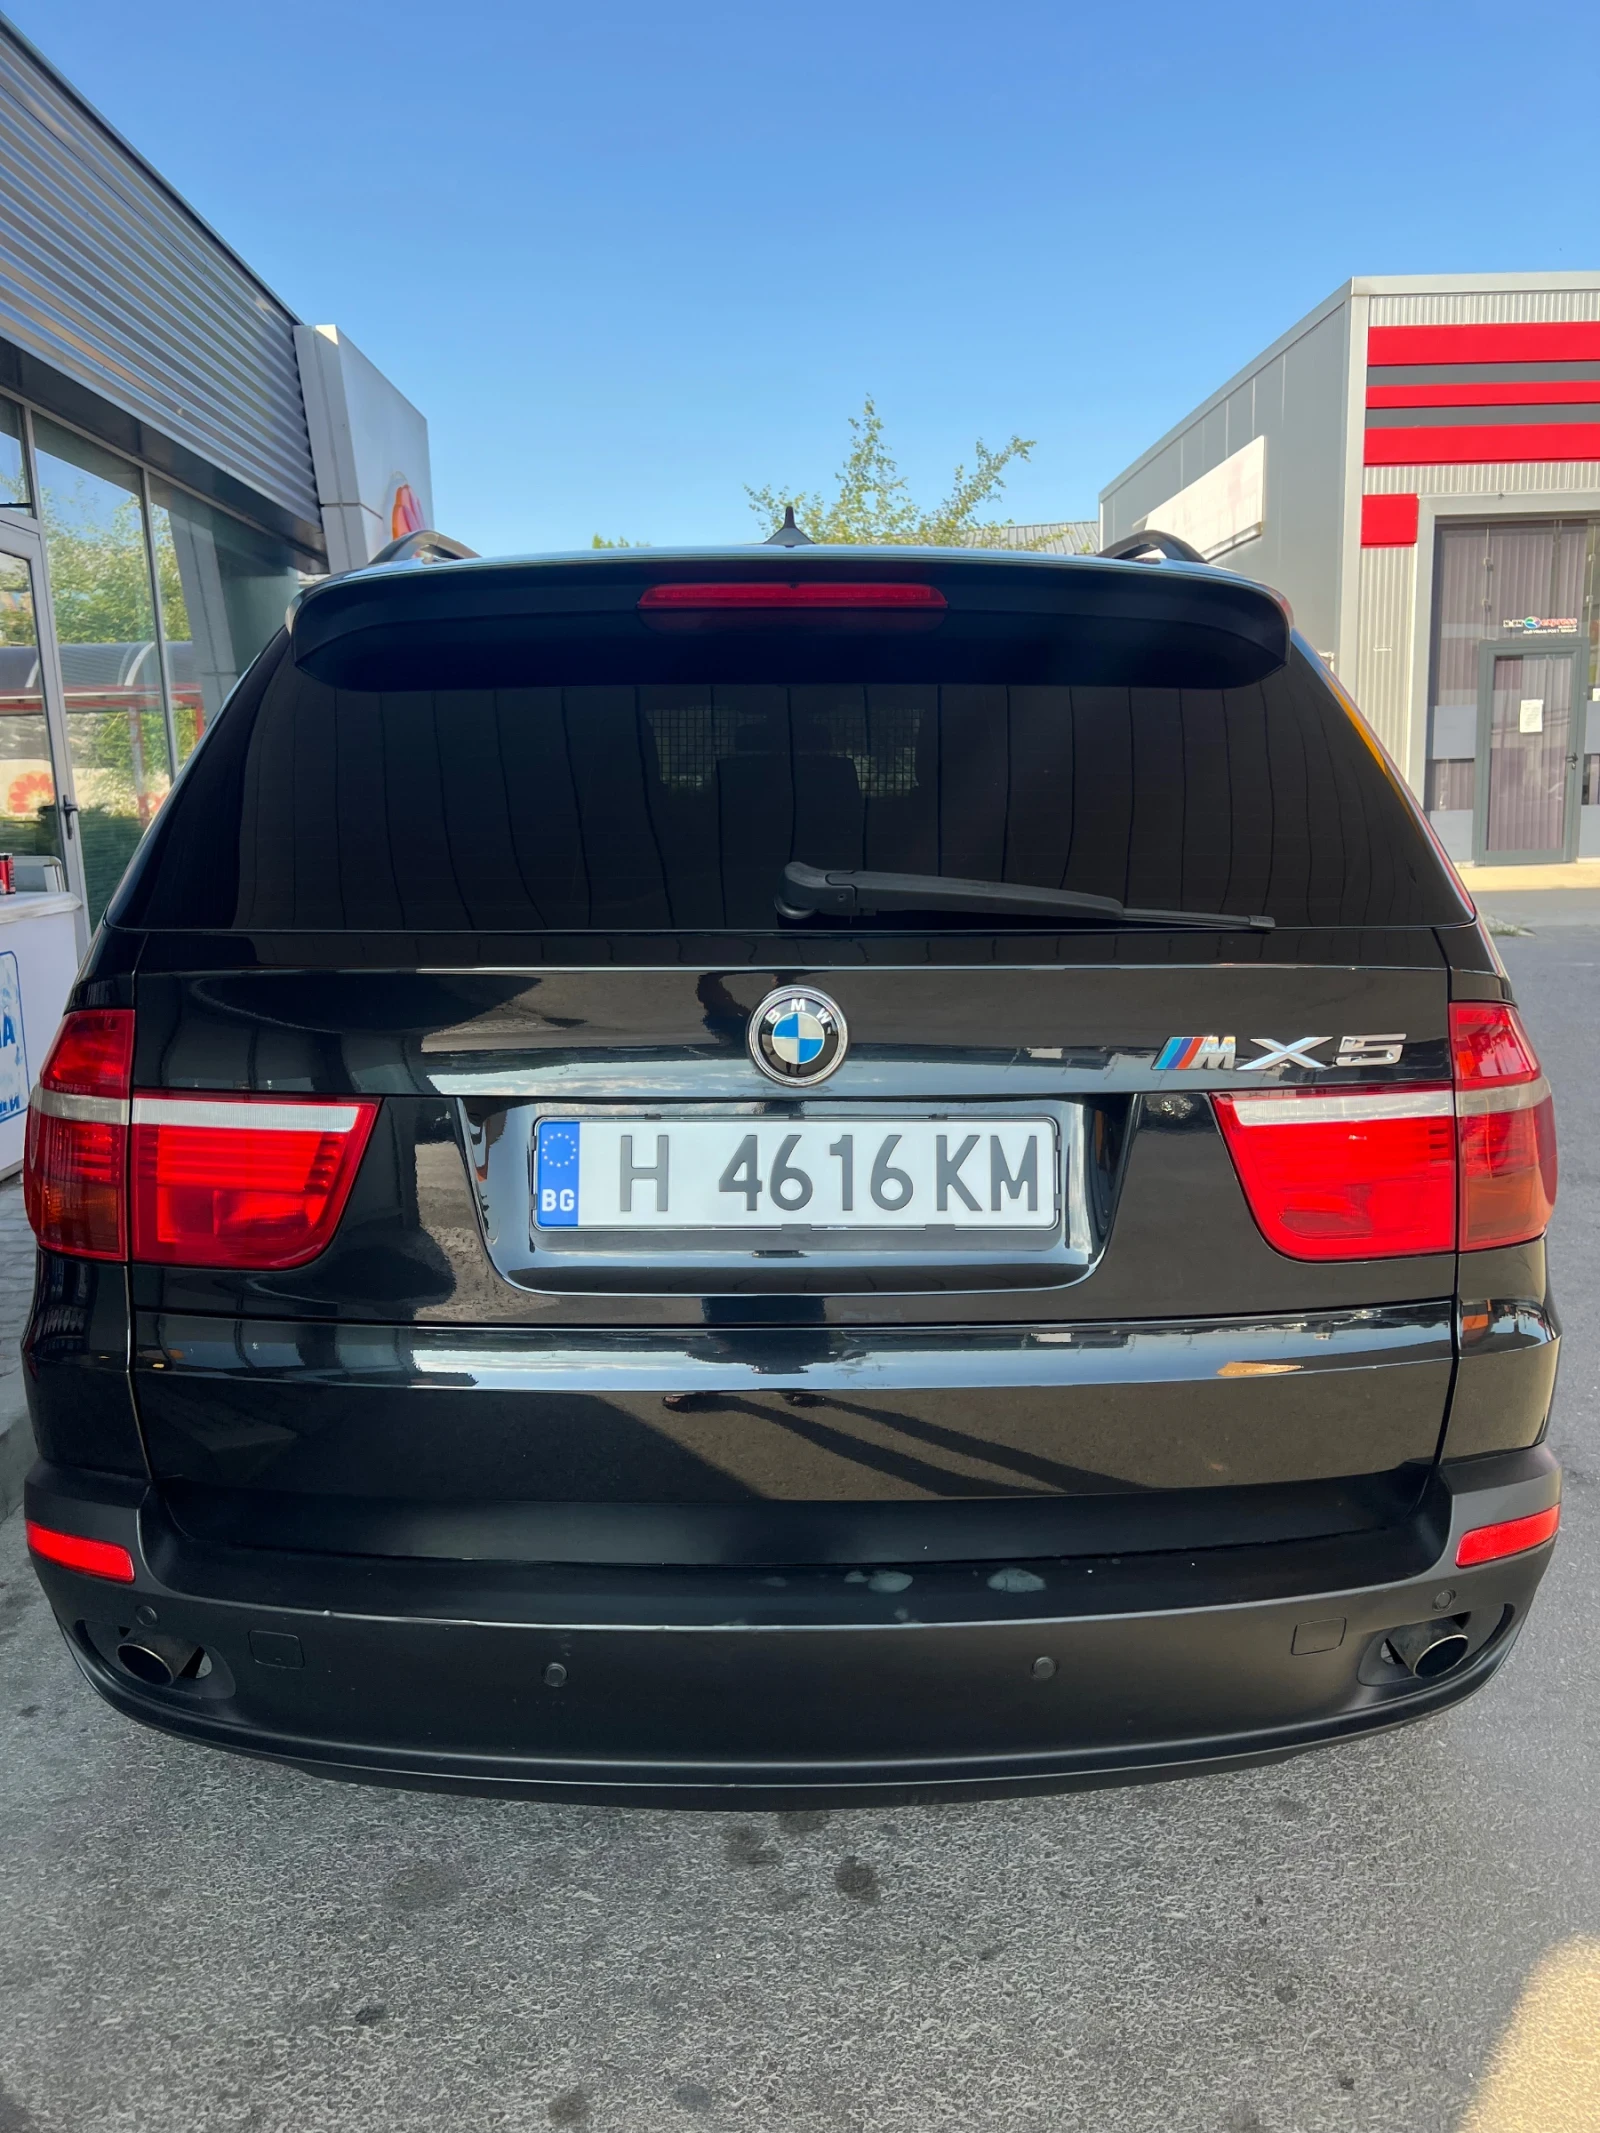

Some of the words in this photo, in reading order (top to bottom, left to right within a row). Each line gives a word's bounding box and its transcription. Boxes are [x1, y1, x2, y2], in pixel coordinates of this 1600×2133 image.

[765, 998, 832, 1025] BMW
[619, 1134, 669, 1212] H
[541, 1188, 575, 1212] BG
